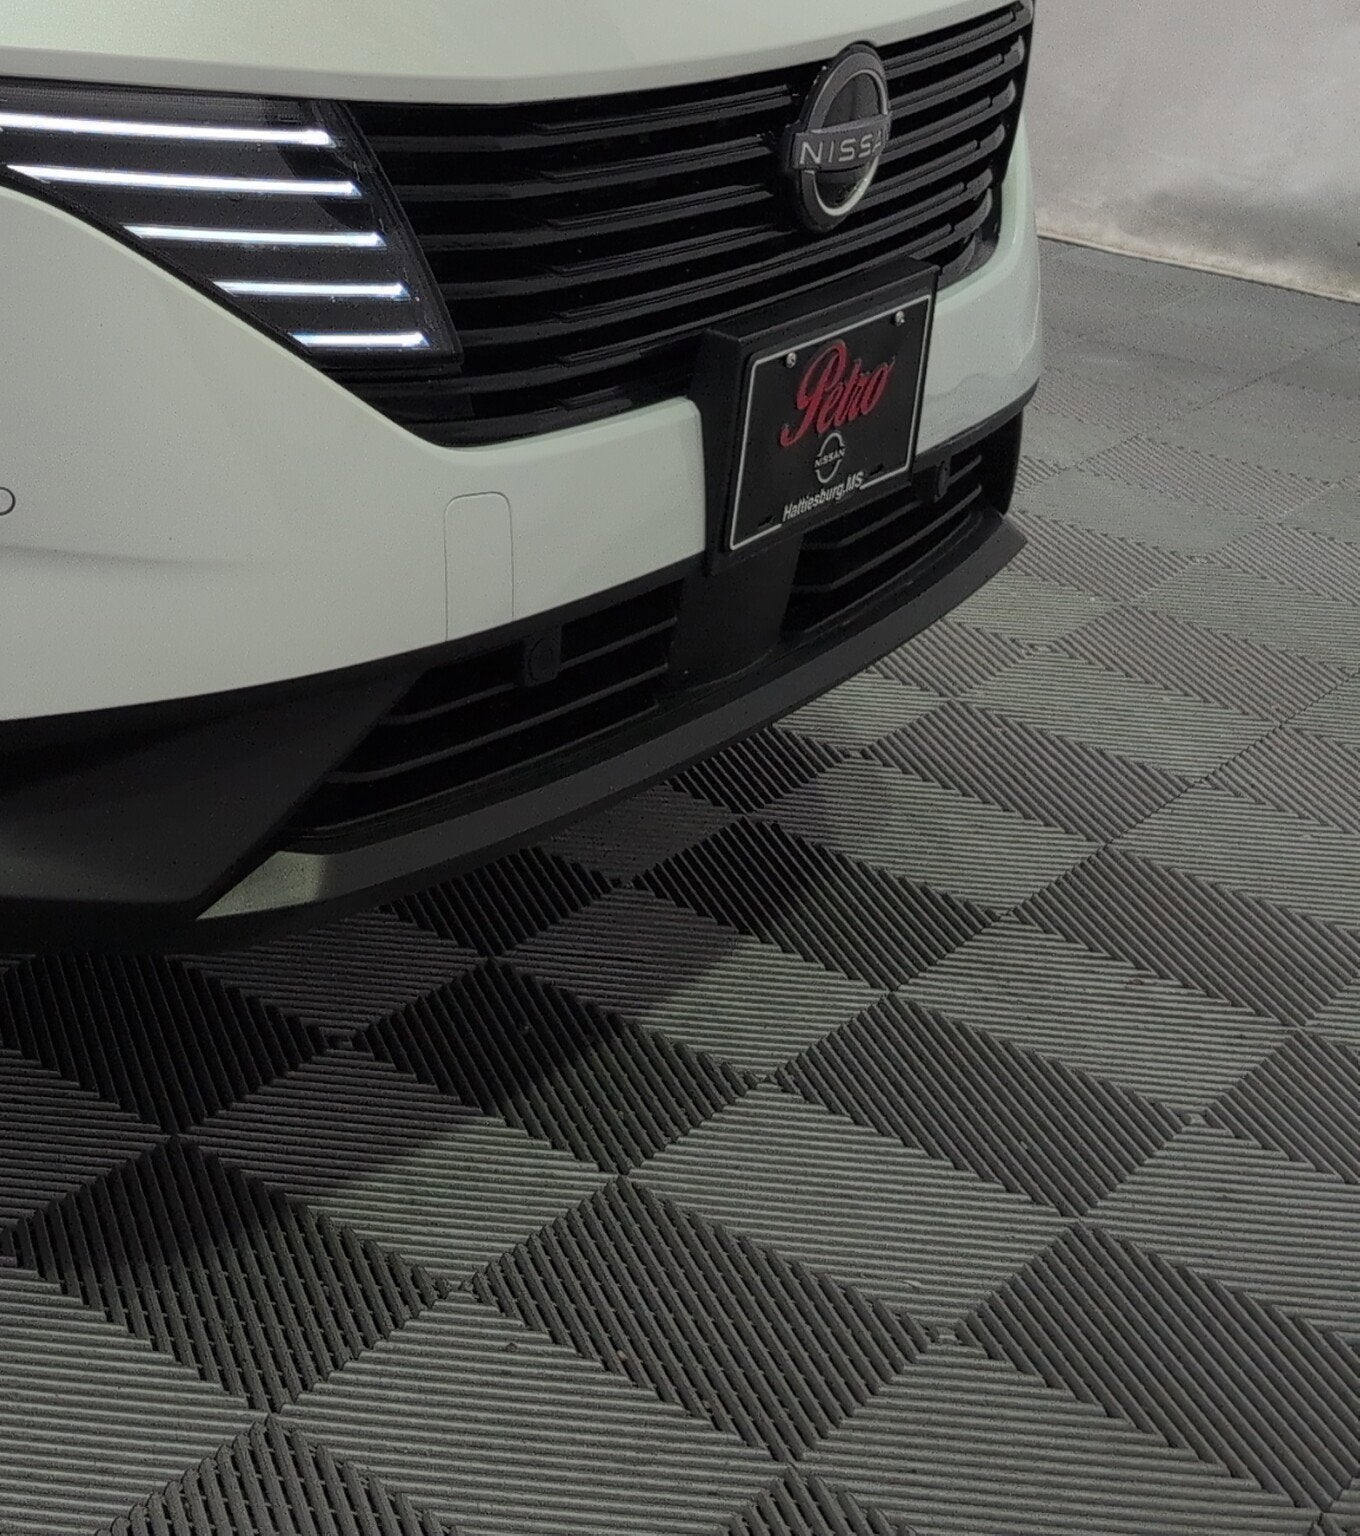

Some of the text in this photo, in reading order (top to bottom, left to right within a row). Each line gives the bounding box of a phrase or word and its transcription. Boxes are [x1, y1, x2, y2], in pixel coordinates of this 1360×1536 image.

[799, 128, 882, 164] NISS
[780, 338, 896, 446] Petro
[814, 447, 846, 469] NISSAN
